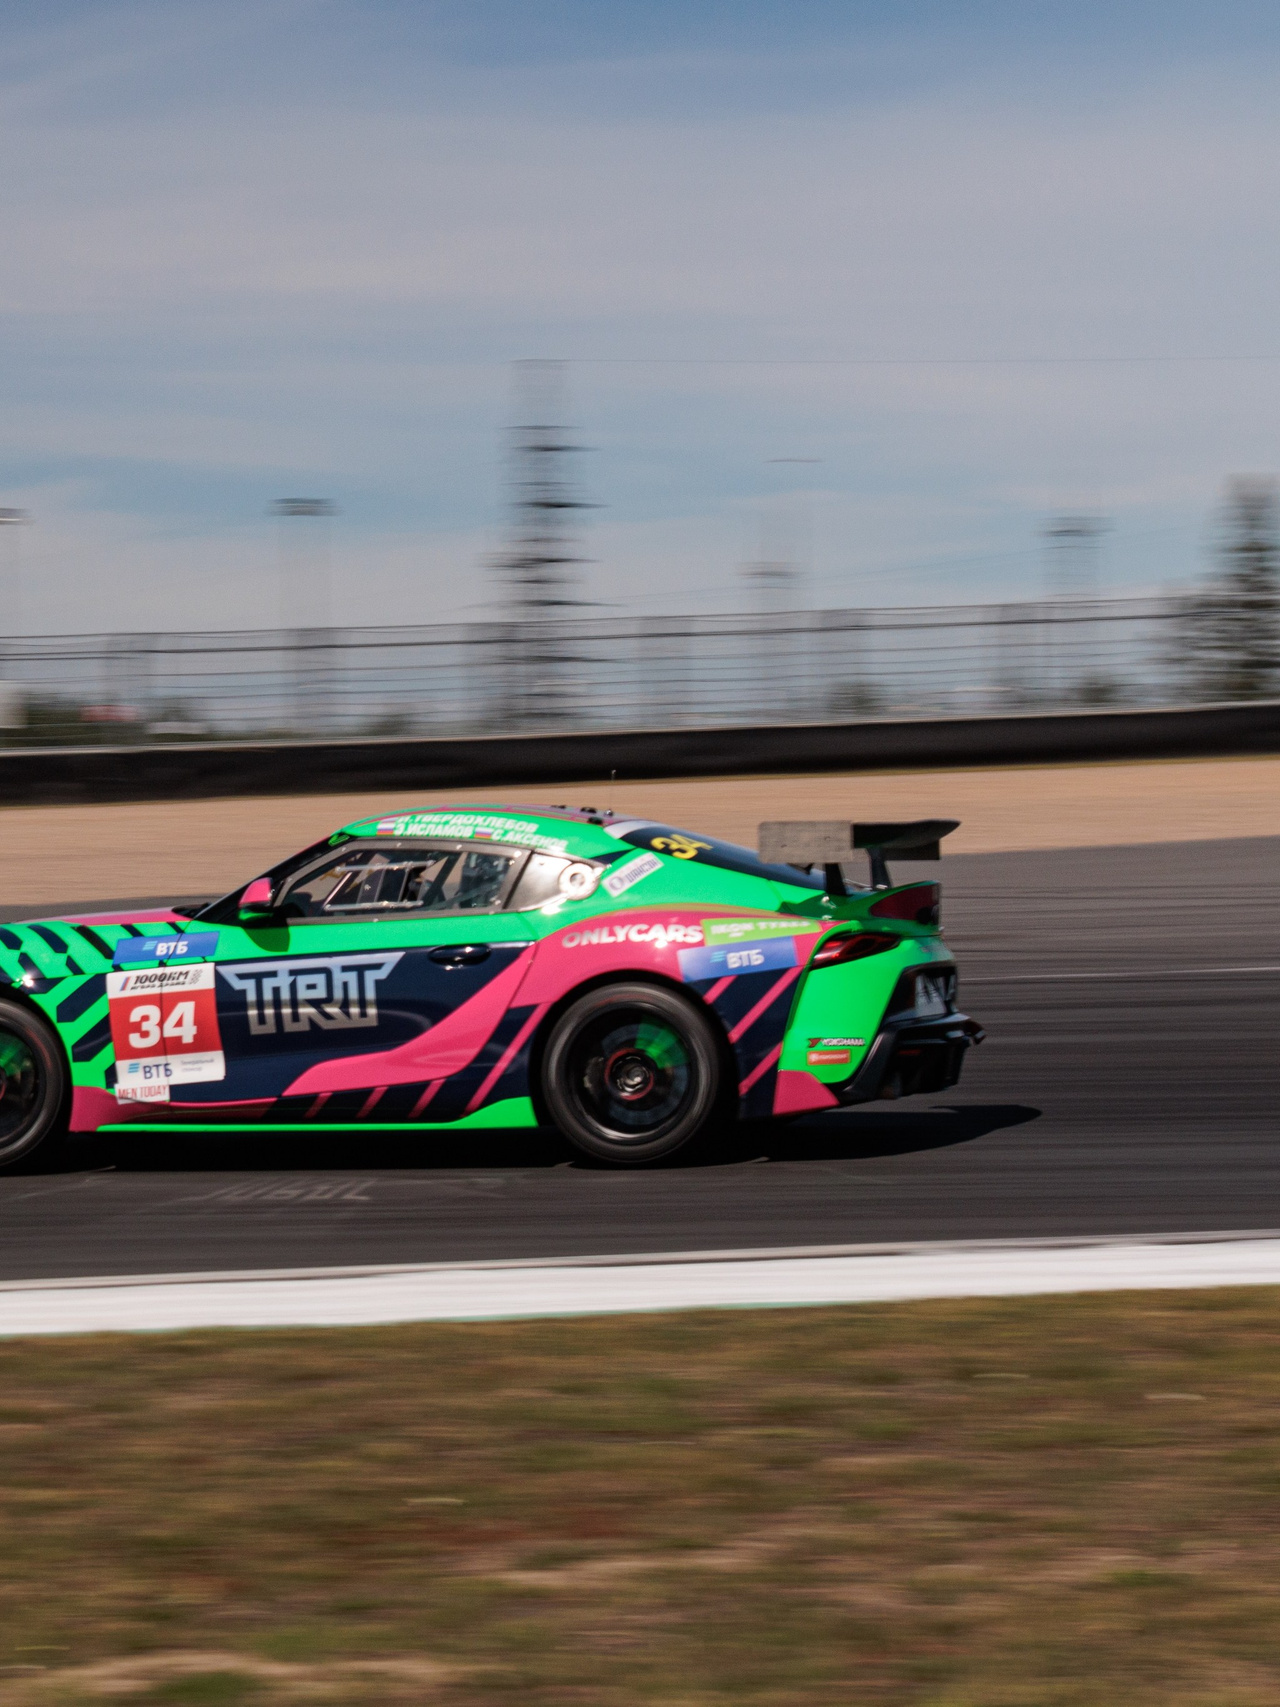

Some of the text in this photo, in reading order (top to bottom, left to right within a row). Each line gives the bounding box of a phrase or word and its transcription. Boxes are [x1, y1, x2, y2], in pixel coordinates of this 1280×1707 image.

[650, 833, 714, 860] 34
[562, 923, 704, 948] ONLYCARS
[155, 940, 189, 957] ВТБ
[726, 948, 765, 969] ВТБ
[216, 951, 406, 1036] TRT
[128, 1000, 198, 1049] 34
[142, 1062, 173, 1080] ВТБ
[117, 1084, 167, 1099] MEN TODAY
